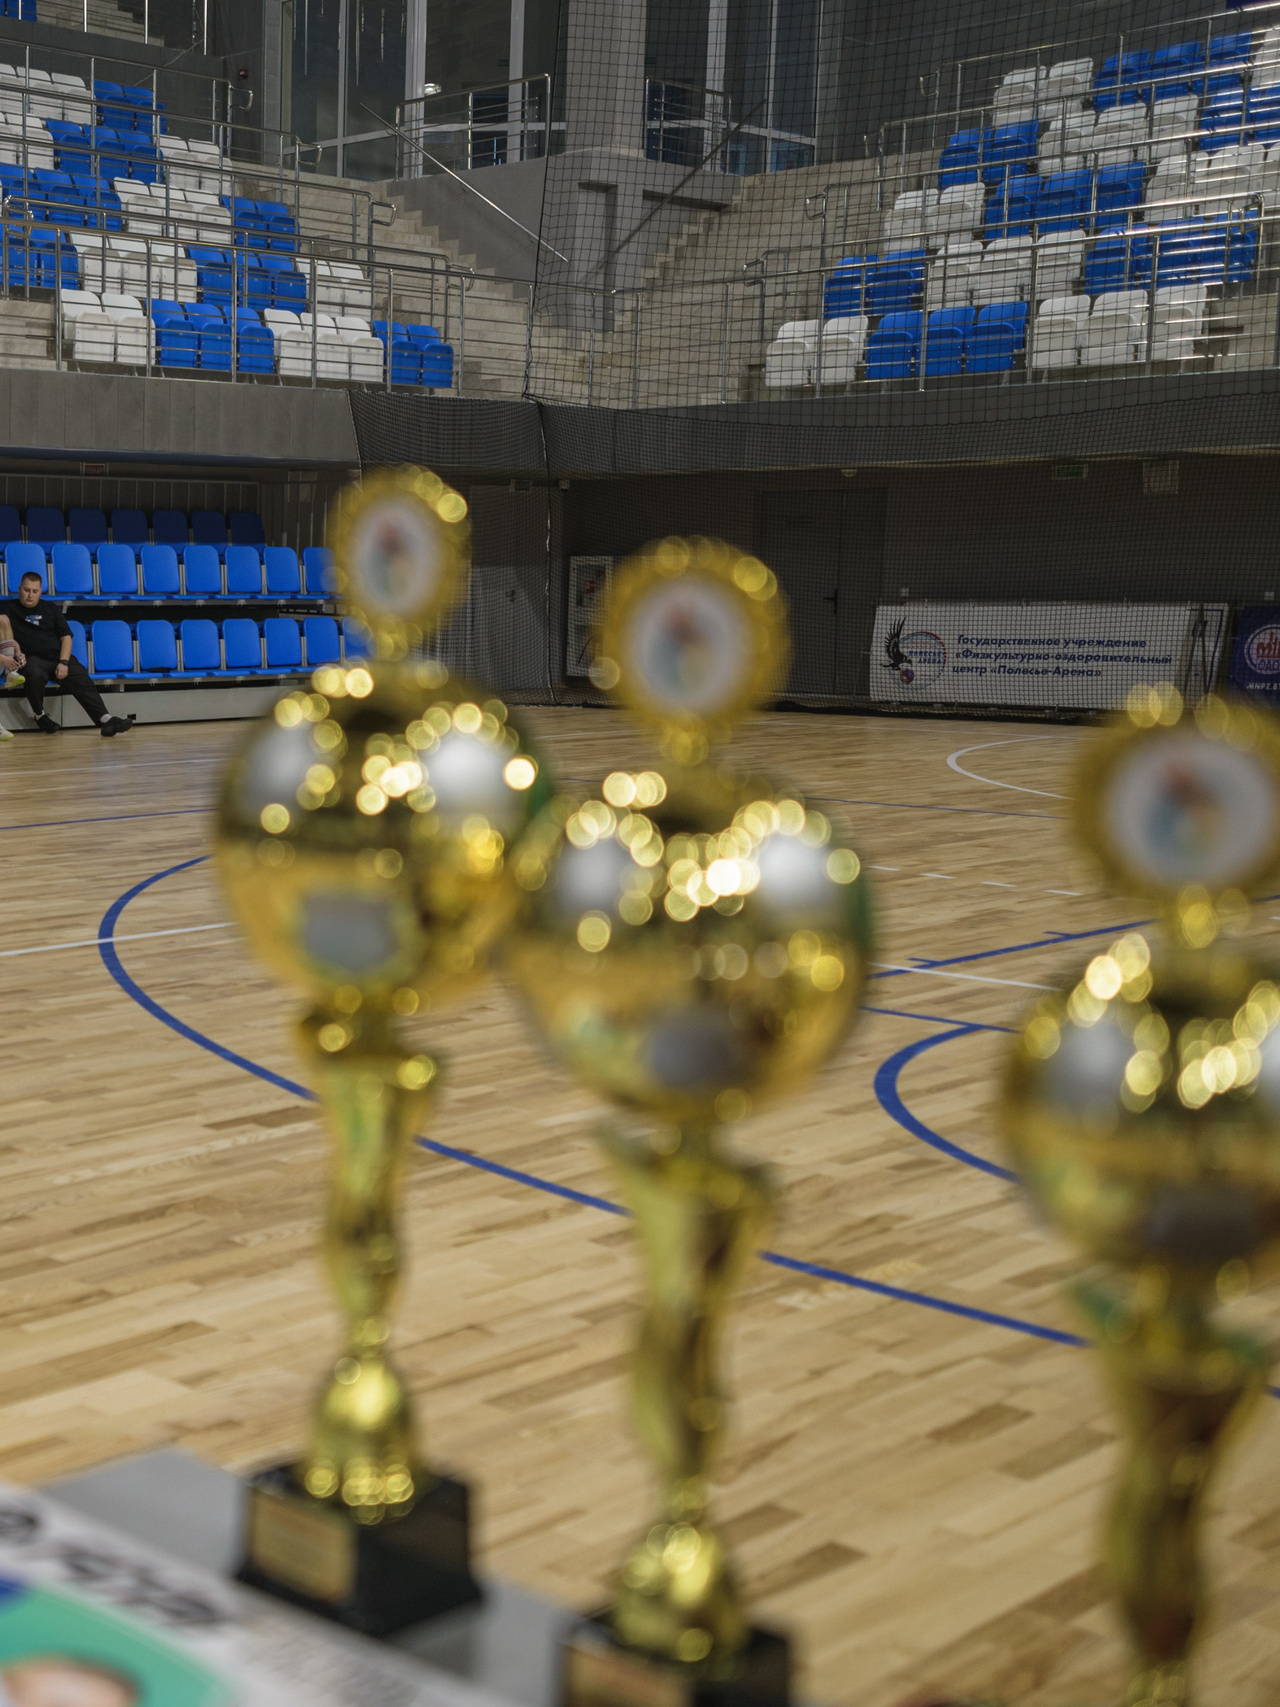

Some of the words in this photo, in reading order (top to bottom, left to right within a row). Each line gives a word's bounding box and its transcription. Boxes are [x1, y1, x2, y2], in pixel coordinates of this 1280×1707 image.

[958, 634, 1060, 649] Государственное
[1063, 638, 1147, 649] учреждение
[955, 648, 1173, 665] «Физкультурно-оздоровительный
[952, 666, 987, 675] центр
[990, 665, 1102, 678] «Полесье-Арена»
